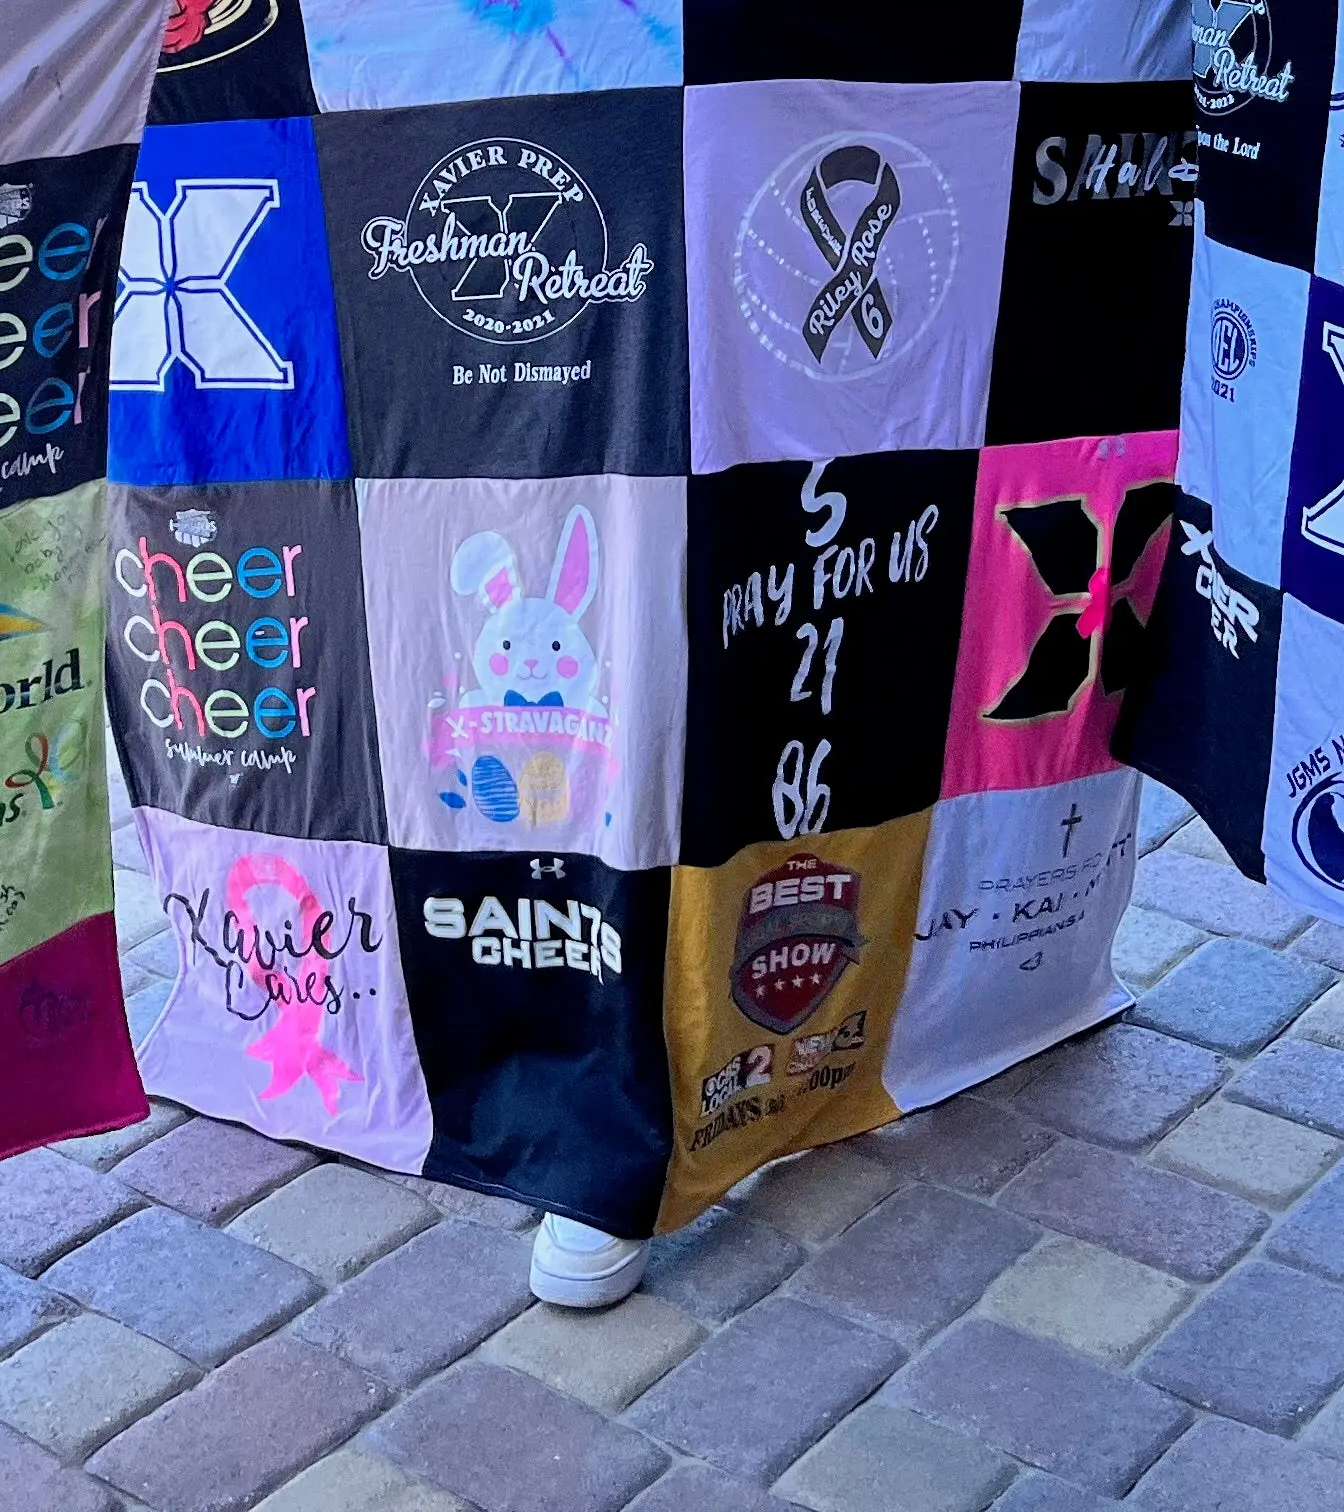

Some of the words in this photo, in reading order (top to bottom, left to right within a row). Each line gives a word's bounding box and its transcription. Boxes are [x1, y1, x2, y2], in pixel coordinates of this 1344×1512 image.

[1212, 46, 1296, 104] Retreat
[1232, 136, 1261, 161] Lord
[418, 145, 508, 218] XAVIER
[516, 147, 585, 206] PREP
[360, 212, 535, 280] Freshman
[512, 242, 655, 305] Retreat
[809, 270, 867, 336] Riley
[851, 202, 893, 268] Rose
[861, 293, 885, 339] 6
[452, 365, 473, 386] Be
[478, 362, 508, 385] Not
[513, 359, 592, 386] Dismayed
[114, 535, 303, 604] cheer
[721, 562, 795, 650] PRAY
[812, 536, 876, 612] FOR
[888, 504, 940, 585] US
[123, 604, 310, 672] cheer
[139, 668, 317, 739] cheer
[1286, 746, 1331, 798] JGMS
[748, 873, 853, 915] BEST
[785, 858, 818, 872] THE
[978, 864, 1078, 894] PRAYERS
[162, 887, 384, 969] Xavier
[914, 907, 980, 942] JAY
[1011, 892, 1064, 923] KAI
[751, 942, 837, 981] SHOW
